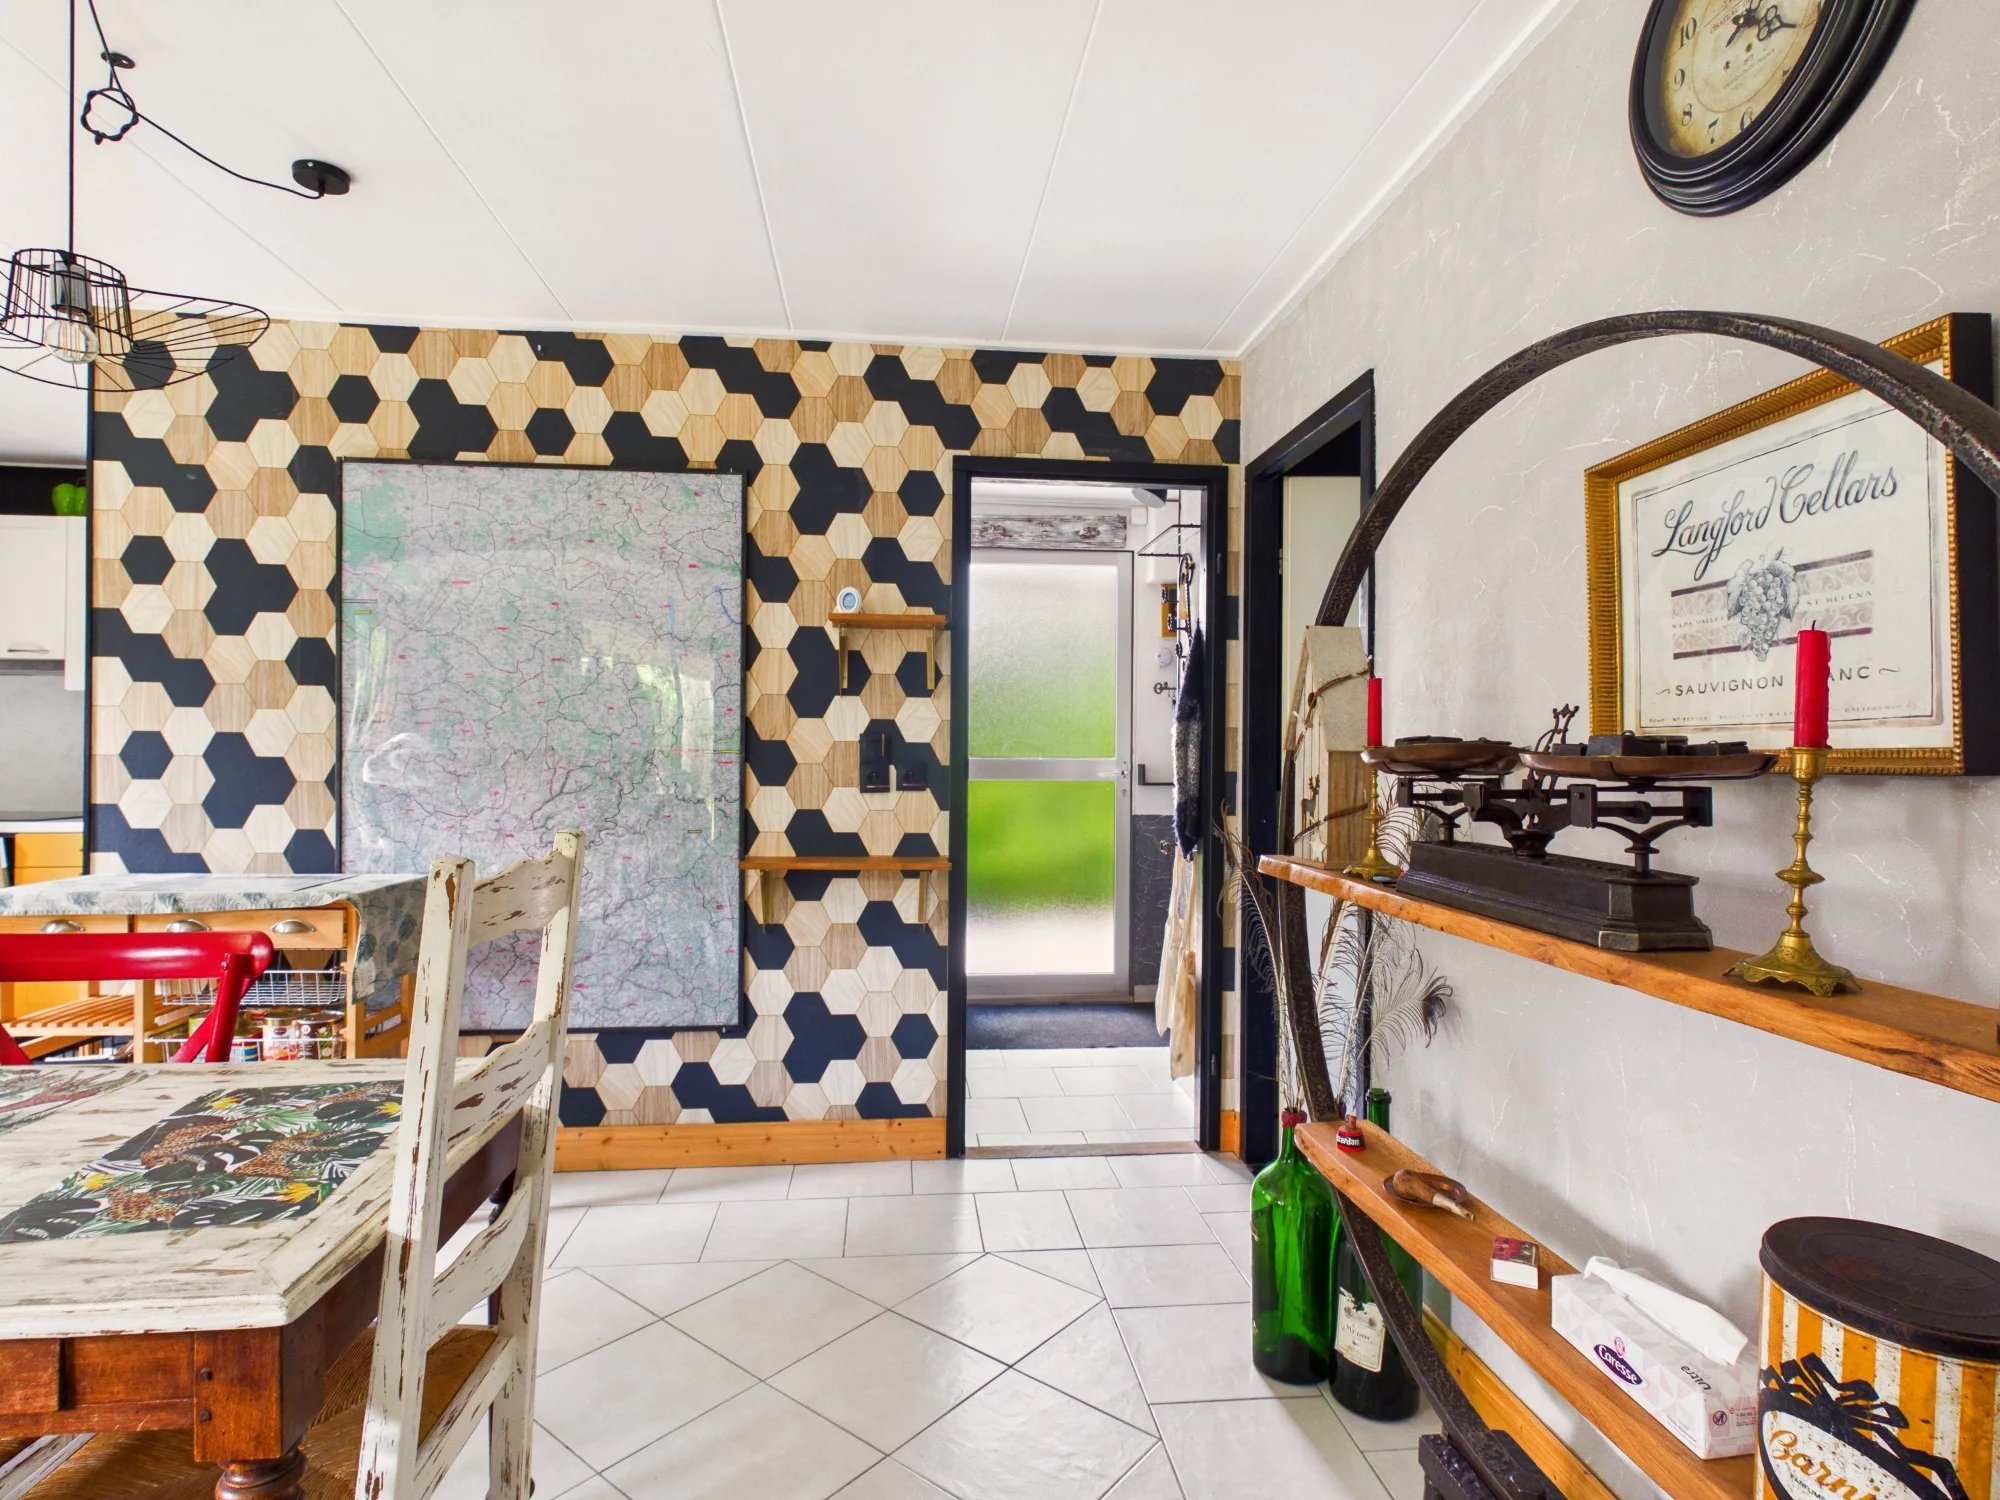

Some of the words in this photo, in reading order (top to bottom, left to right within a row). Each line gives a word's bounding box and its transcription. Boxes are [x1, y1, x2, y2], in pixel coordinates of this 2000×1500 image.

[1679, 17, 1697, 48] 10
[1673, 68, 1686, 91] 9
[1681, 103, 1693, 126] 8
[1708, 118, 1719, 144] 7
[1652, 477, 1778, 581] Langford
[1778, 450, 1898, 523] Cellars
[1674, 674, 1785, 697] SAUVIGNON
[1598, 1344, 1638, 1385] Caresse
[1681, 1365, 1712, 1390] Ultra
